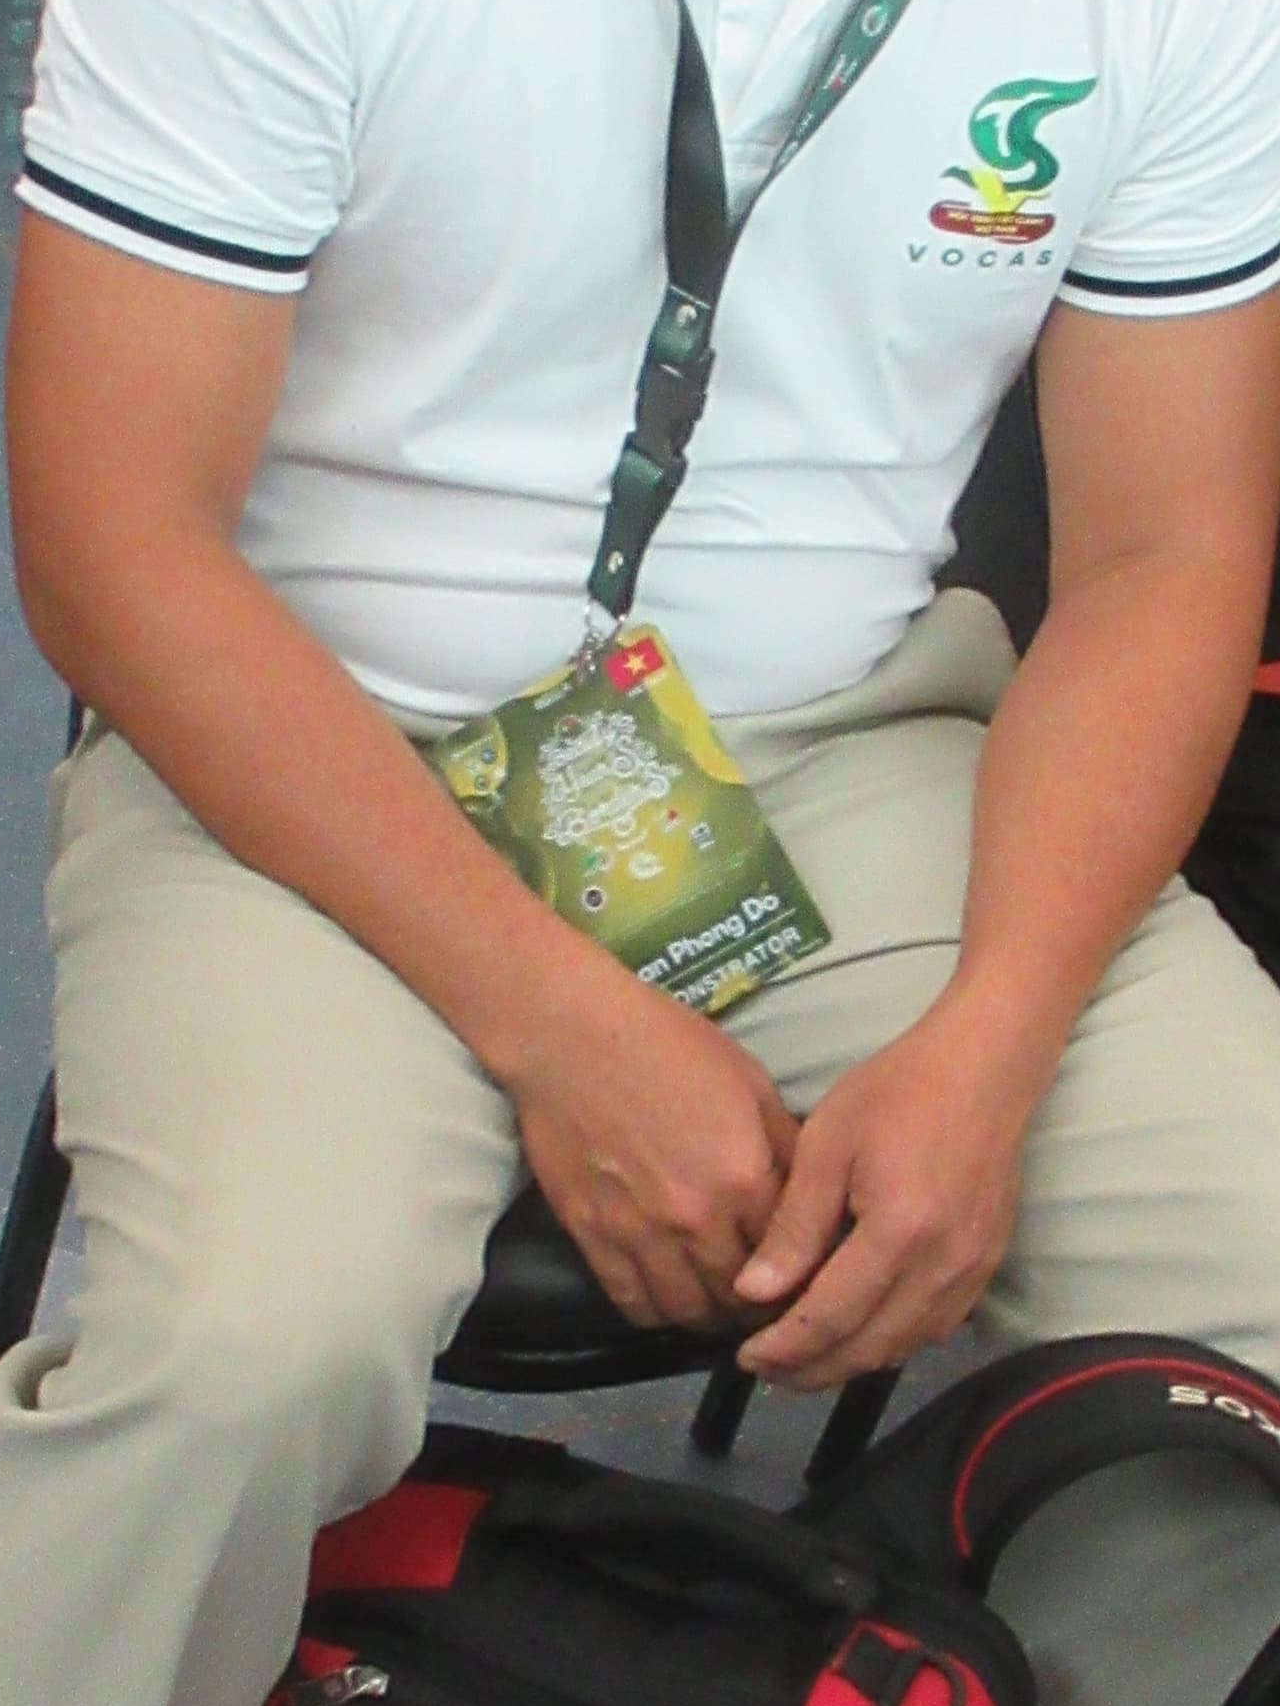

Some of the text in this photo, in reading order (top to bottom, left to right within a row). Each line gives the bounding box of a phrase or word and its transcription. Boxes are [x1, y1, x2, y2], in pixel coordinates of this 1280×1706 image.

[907, 244, 1053, 267] VOCAS
[637, 894, 780, 983] an Phong Do
[671, 926, 803, 1004] ONSTRATOR
